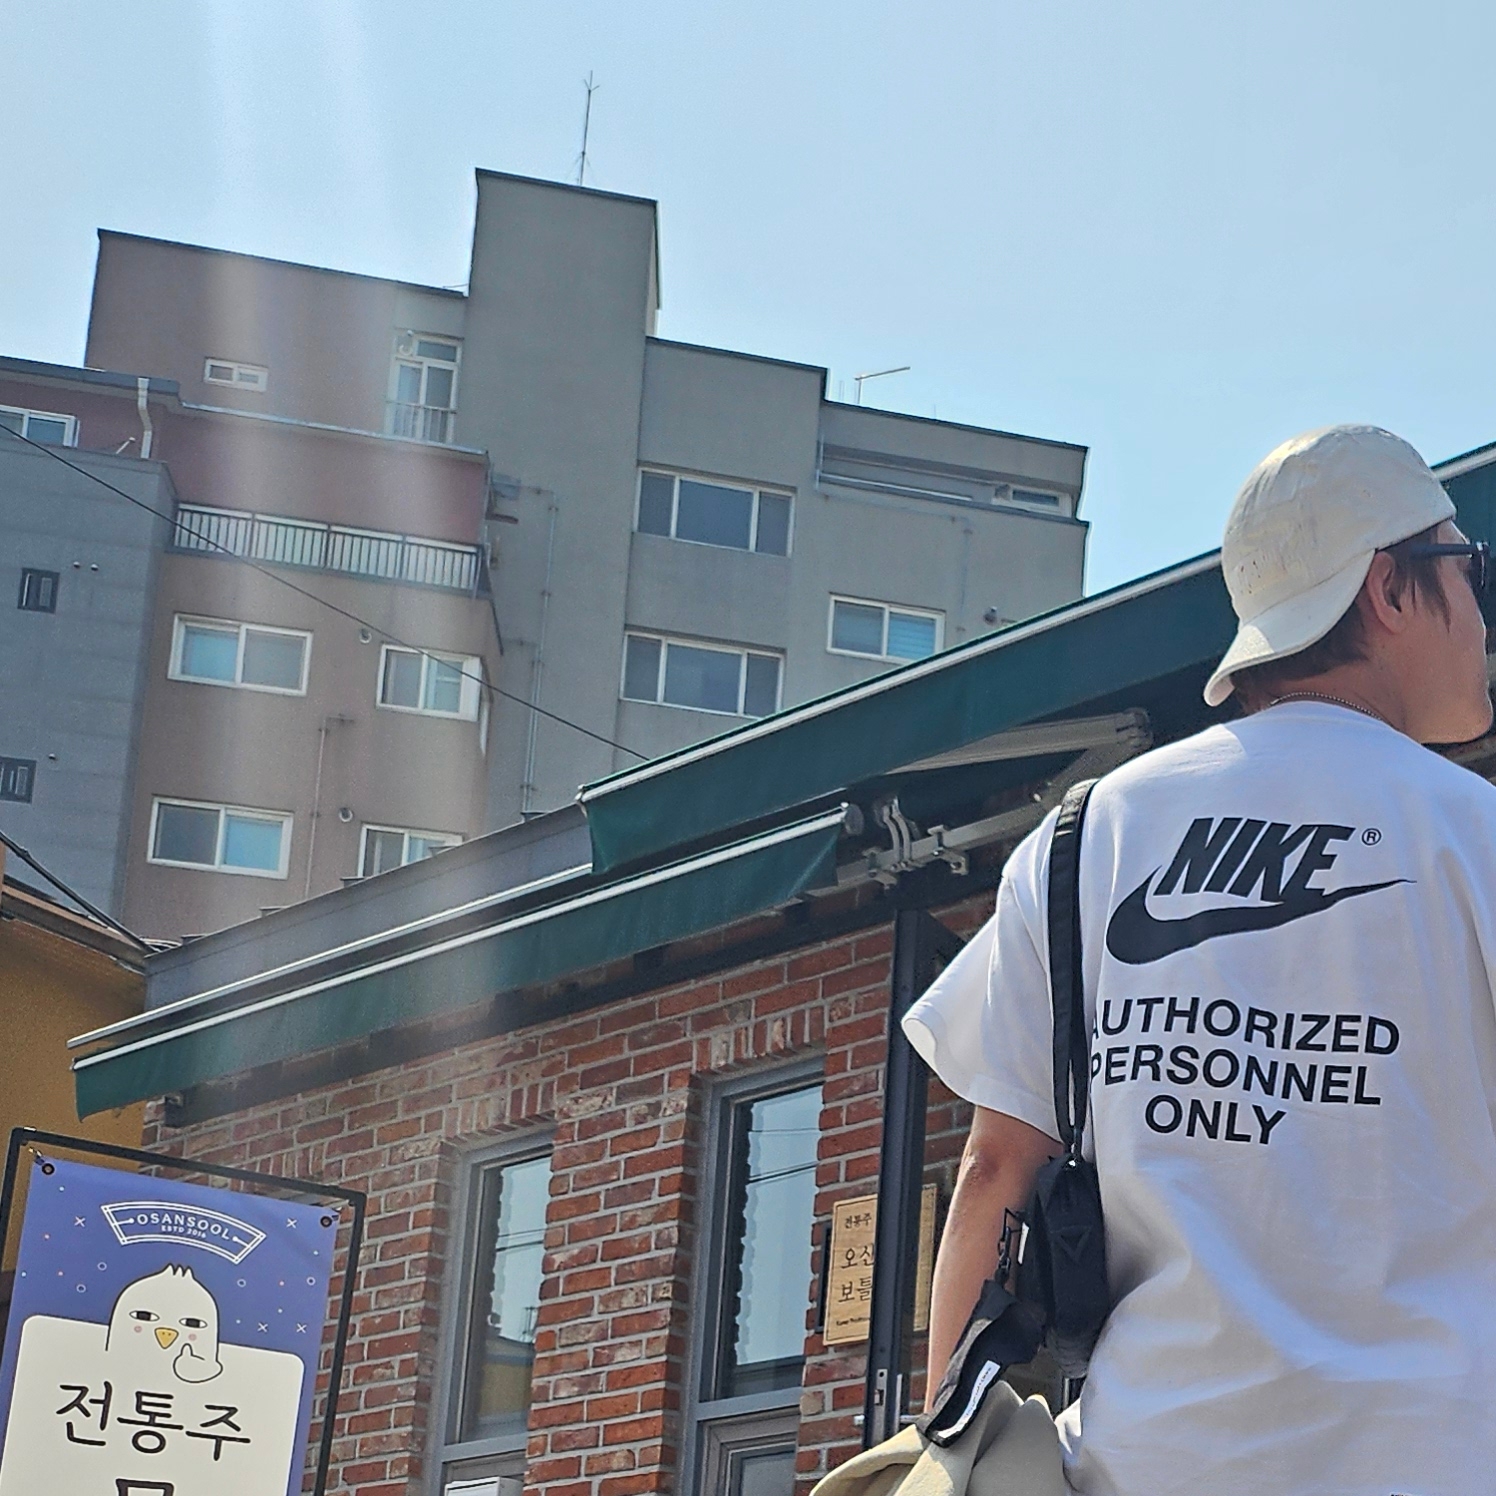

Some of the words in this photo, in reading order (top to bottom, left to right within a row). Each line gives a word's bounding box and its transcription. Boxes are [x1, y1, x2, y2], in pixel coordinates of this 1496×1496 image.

[1153, 817, 1356, 901] NIKE
[1145, 1095, 1287, 1145] ONLY
[136, 1213, 230, 1240] OSANSOOL
[161, 1225, 184, 1233] ESTD
[187, 1228, 207, 1239] 2016
[56, 1381, 251, 1461] 전통주
